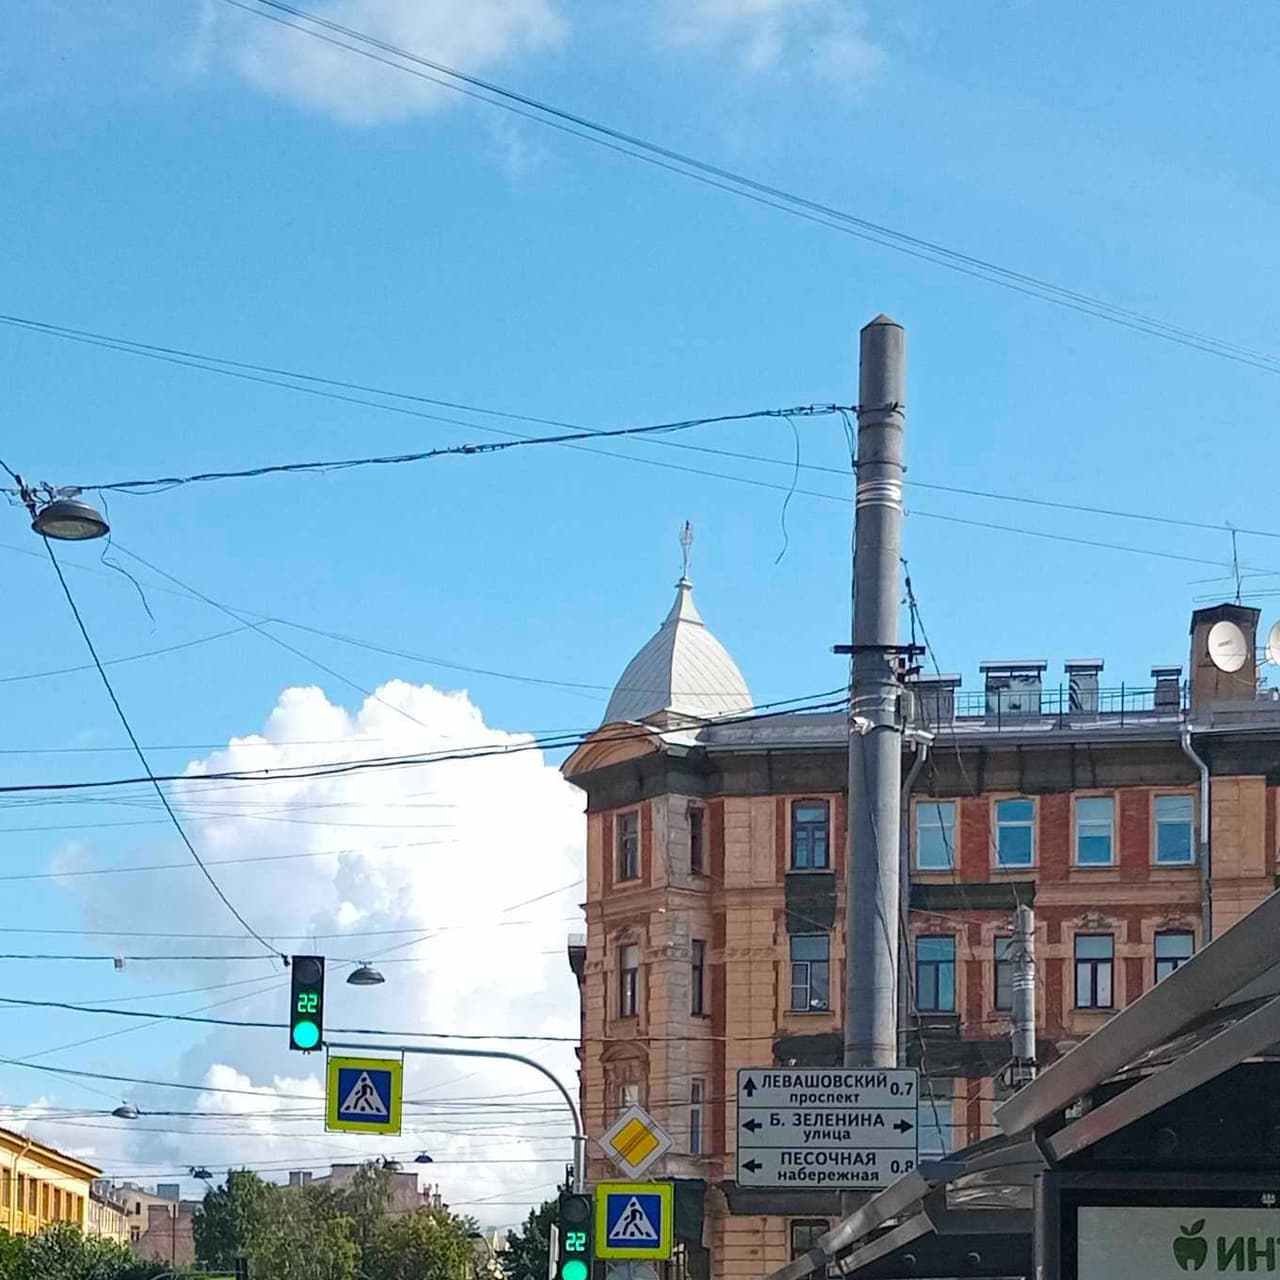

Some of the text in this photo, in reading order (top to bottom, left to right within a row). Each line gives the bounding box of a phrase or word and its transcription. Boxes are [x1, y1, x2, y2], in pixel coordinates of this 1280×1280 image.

[297, 993, 318, 1012] 22
[761, 1073, 887, 1089] ЛЕВАШОВСКИЙ
[890, 1082, 914, 1096] 0.7
[789, 1093, 860, 1106] проспект
[770, 1113, 885, 1127] Б. ЗЕЛЕНИНА
[803, 1131, 851, 1143] улица
[781, 1152, 877, 1166] ПЕСОЧНАЯ
[777, 1169, 880, 1184] набережная
[565, 1232, 586, 1252] 22
